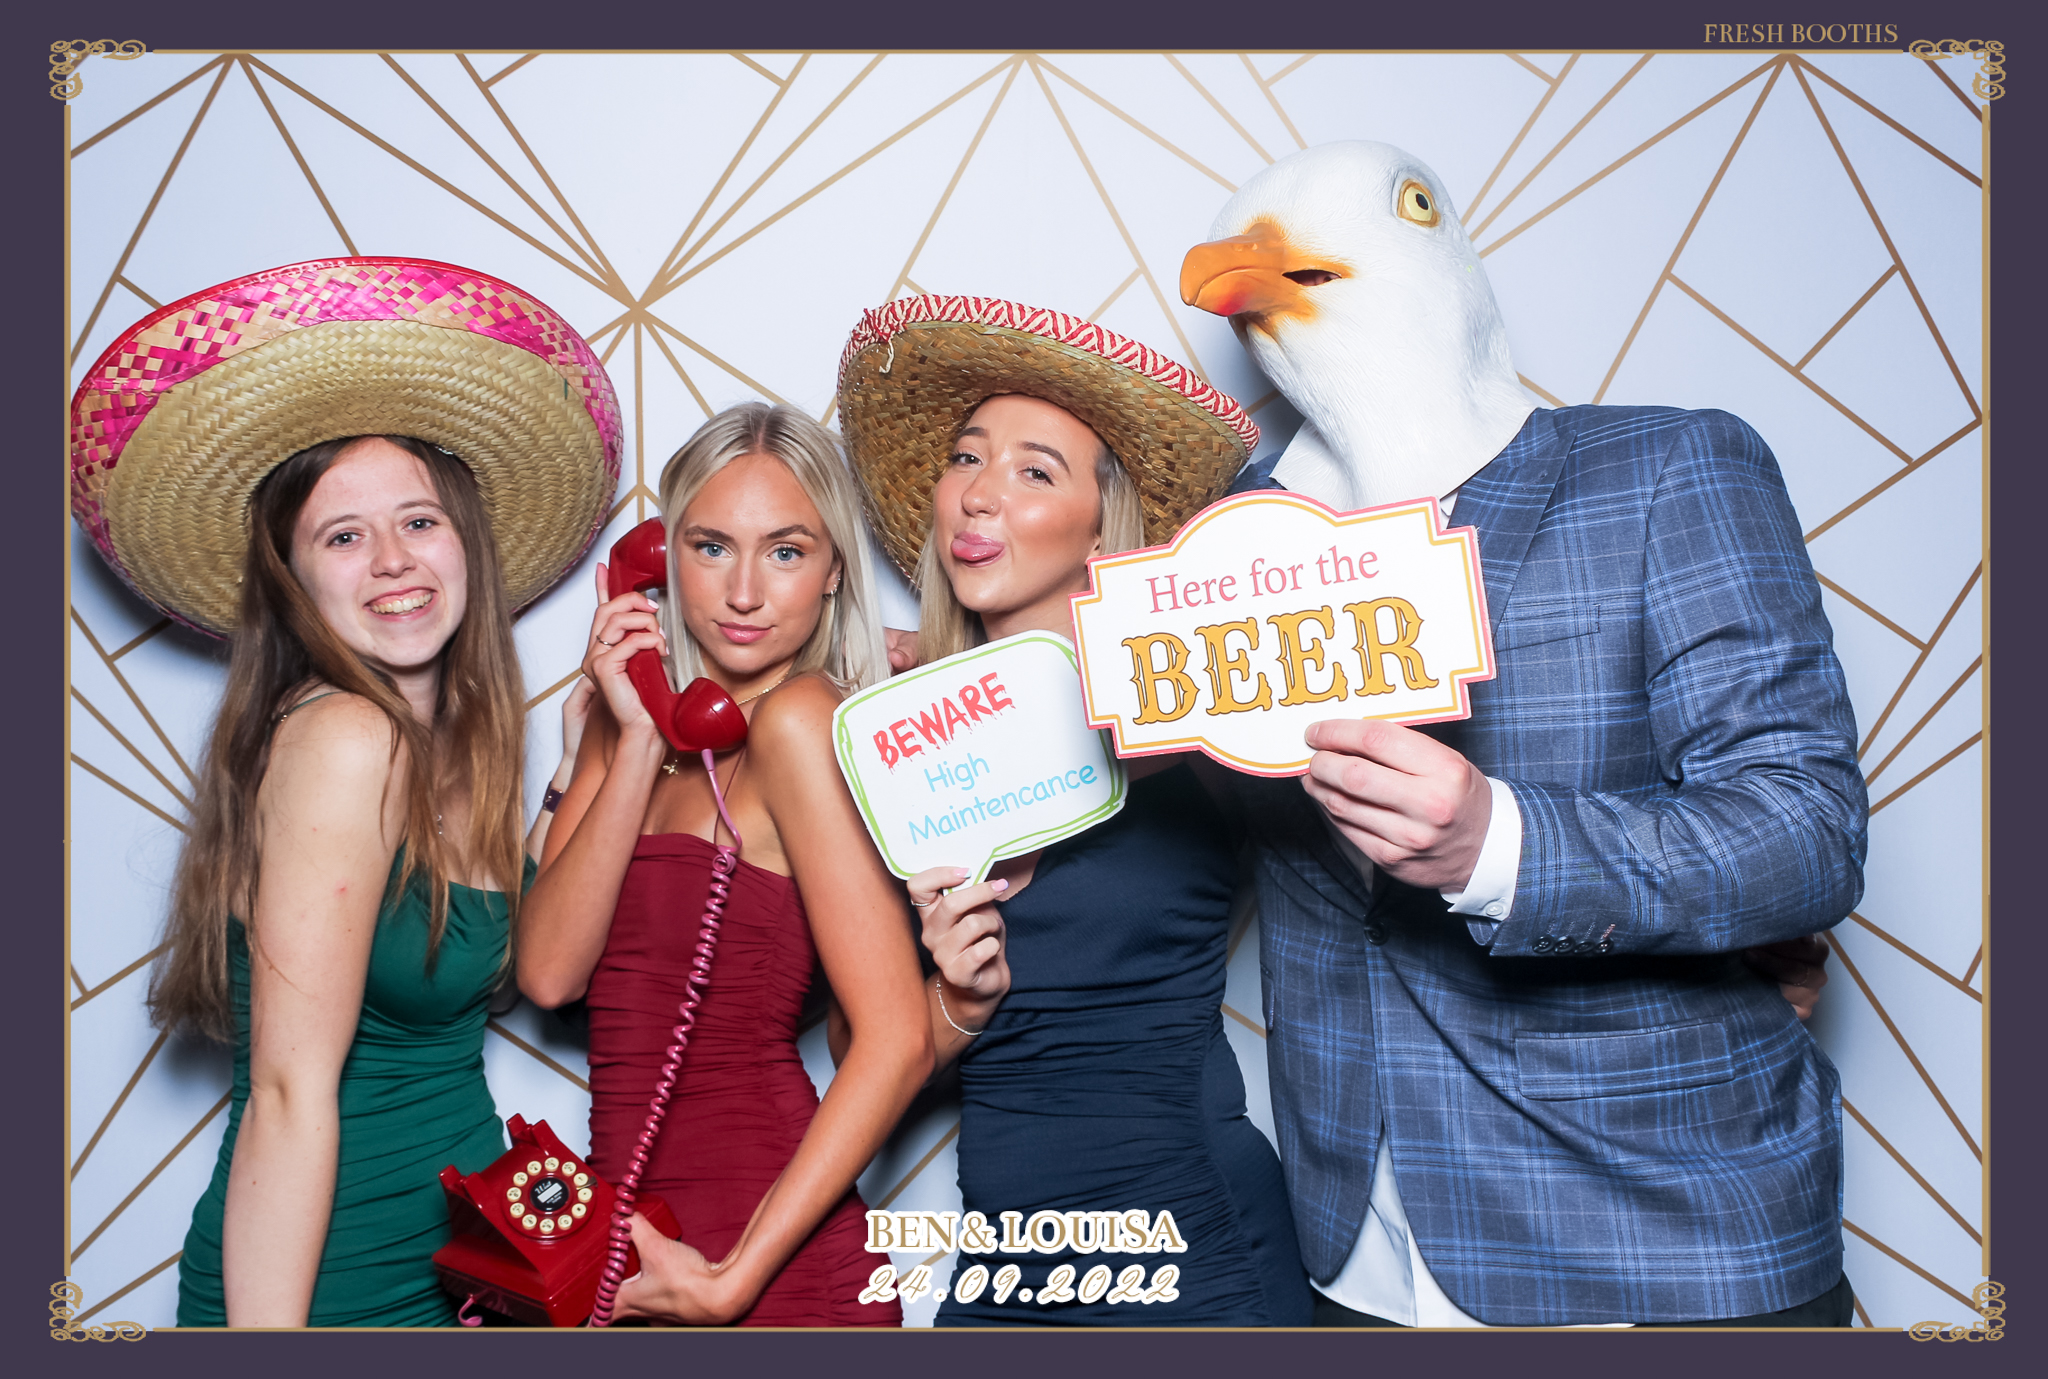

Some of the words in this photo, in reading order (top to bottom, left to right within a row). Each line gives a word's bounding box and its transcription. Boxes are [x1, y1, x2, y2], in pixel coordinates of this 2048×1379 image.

[1146, 573, 1239, 613] Here
[1249, 558, 1304, 597] for
[1315, 545, 1380, 585] the
[1121, 596, 1440, 726] BEER
[873, 671, 1016, 775] BEWARE
[908, 764, 1098, 845] Maintencance
[924, 753, 990, 793] High
